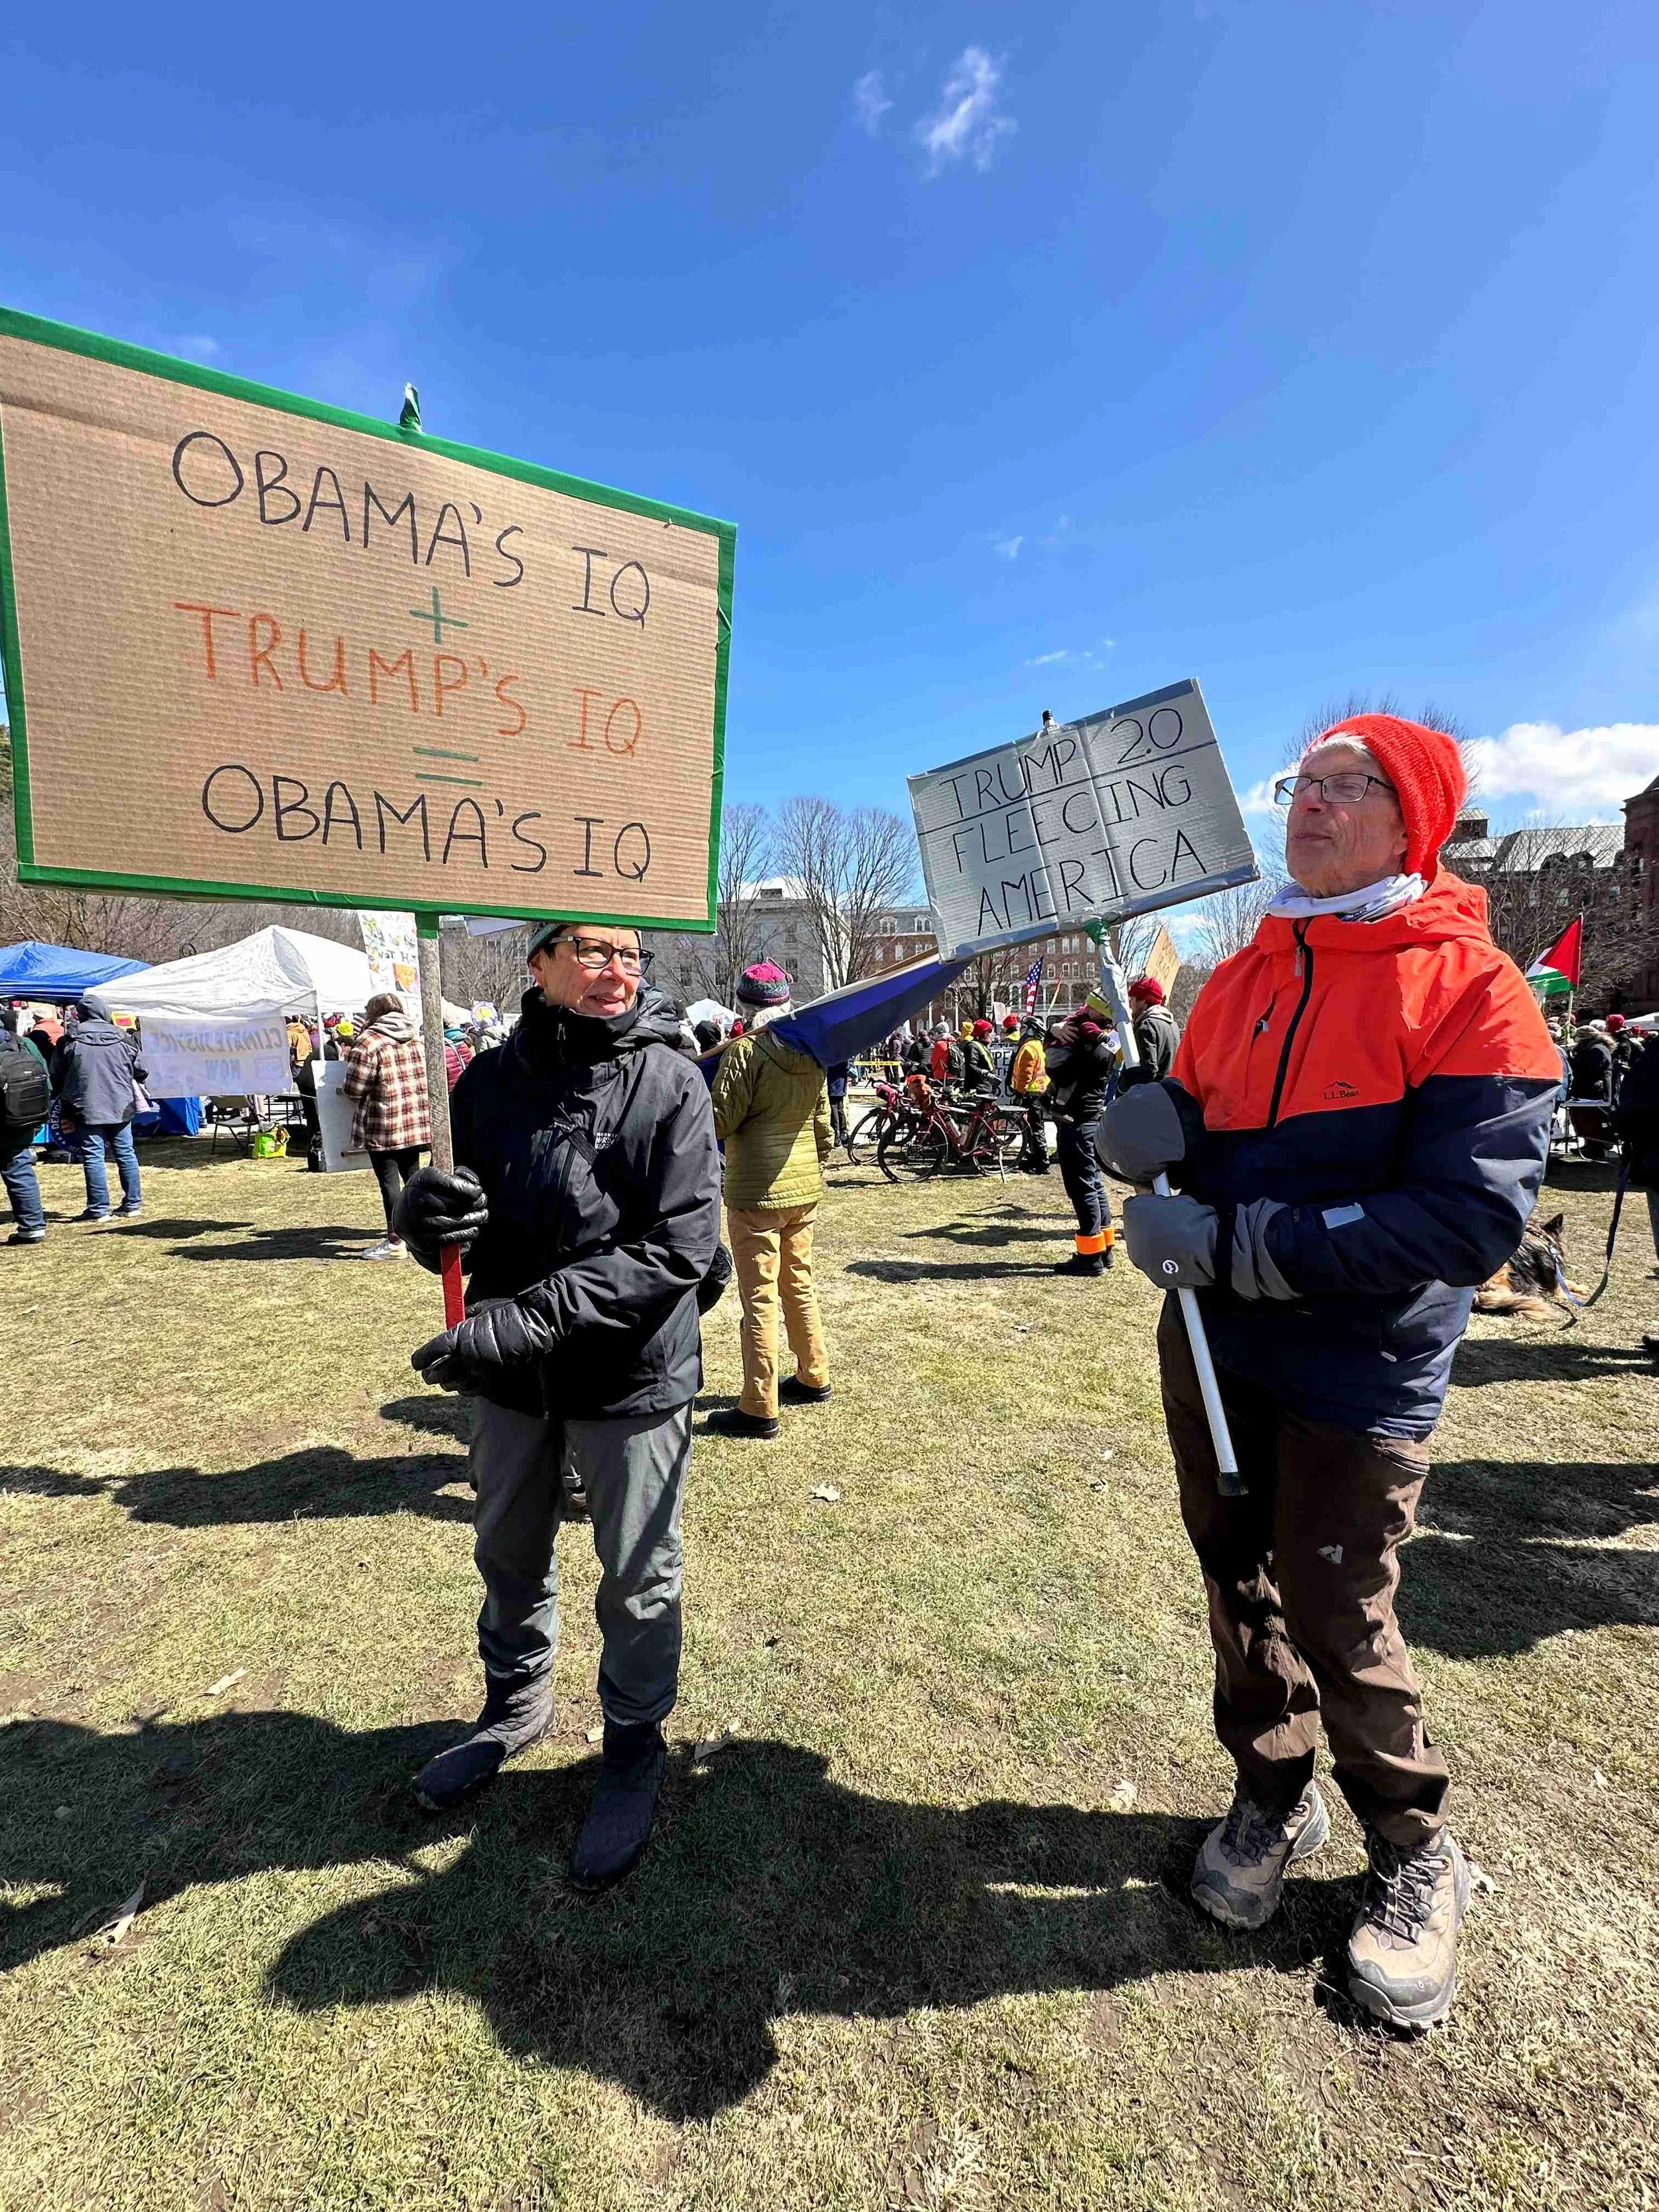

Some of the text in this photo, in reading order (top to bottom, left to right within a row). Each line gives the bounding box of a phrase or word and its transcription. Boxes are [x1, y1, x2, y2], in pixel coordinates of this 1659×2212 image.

[172, 430, 652, 630] OBAMA'S IQ
[174, 601, 643, 758] TRUMP'S IQ
[938, 707, 1184, 819] TRUMP 2.0
[951, 765, 1192, 873] FLEECING
[201, 763, 651, 884] OBAMA'S IQ
[977, 828, 1208, 937] AMERICA
